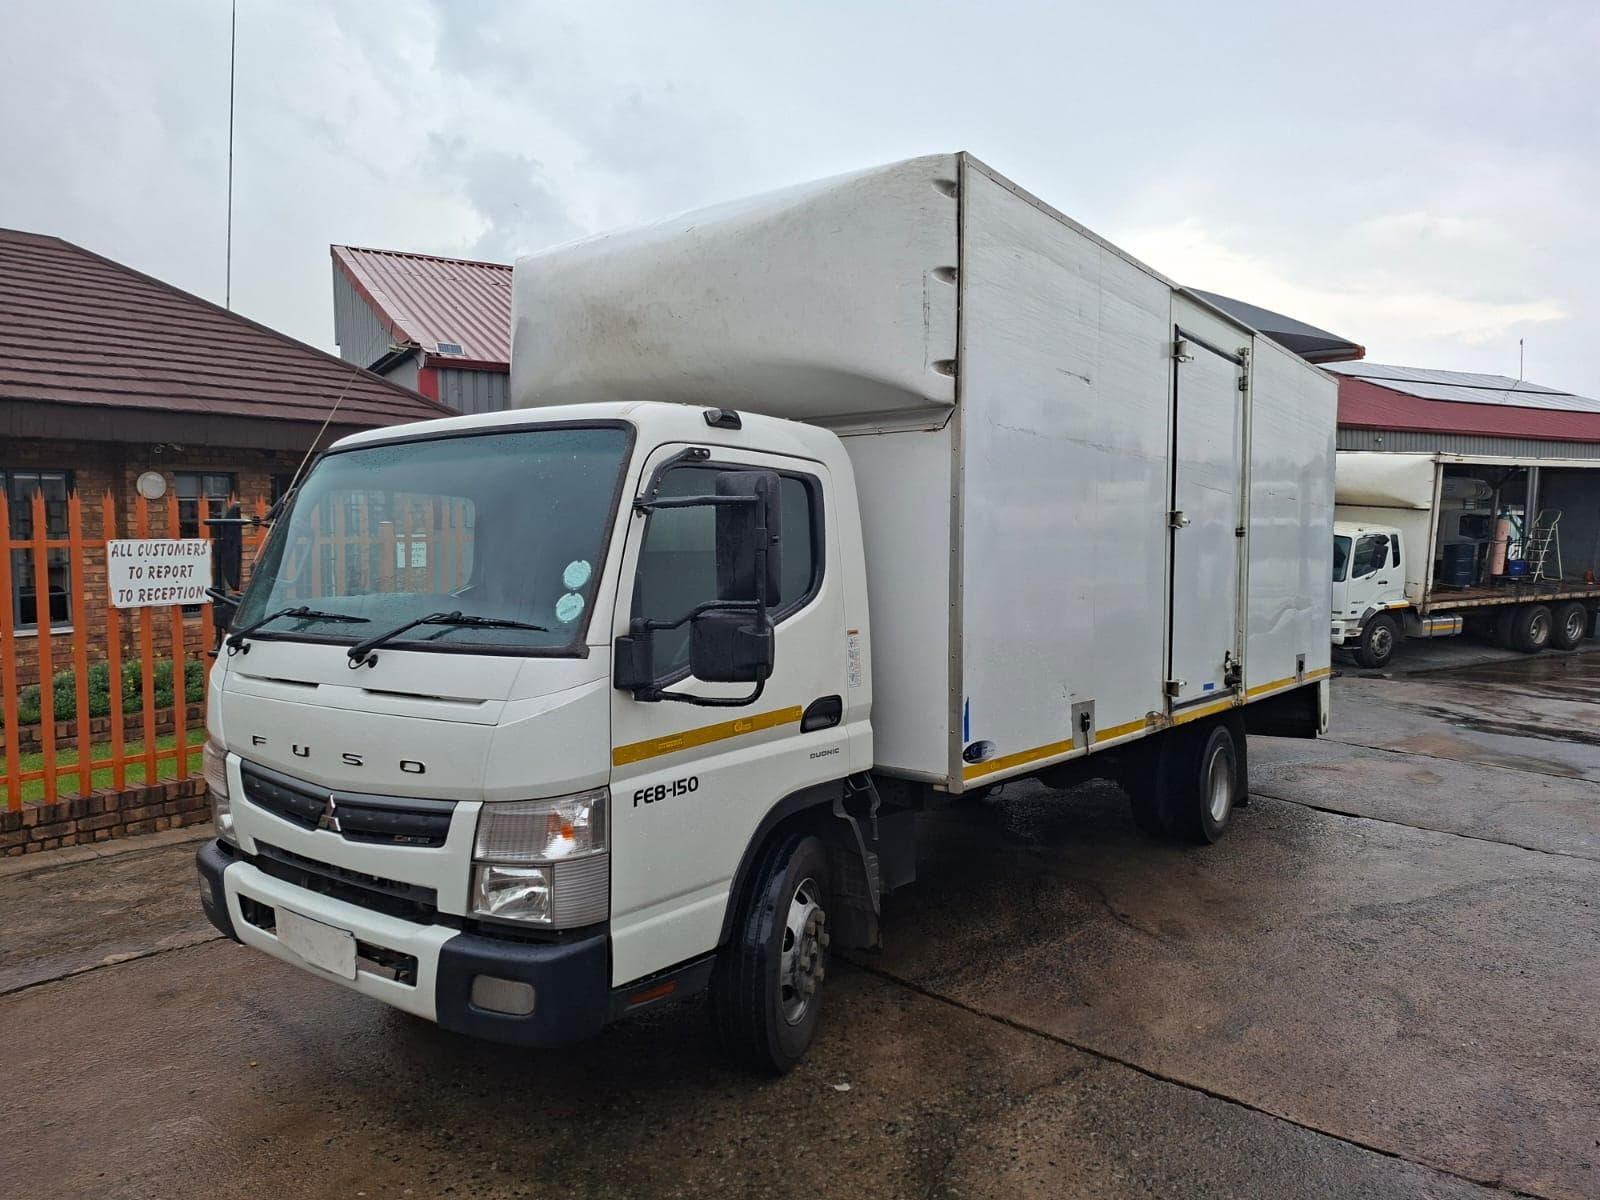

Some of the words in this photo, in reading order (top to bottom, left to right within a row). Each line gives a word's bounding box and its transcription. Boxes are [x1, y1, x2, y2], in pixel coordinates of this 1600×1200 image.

[112, 544, 133, 557] ALL
[138, 543, 208, 557] CUSTOMERS
[128, 566, 143, 580] TO
[148, 565, 194, 579] REPORT
[119, 589, 134, 602] TO
[138, 586, 204, 602] RECEPTION
[252, 735, 426, 774] FUSO
